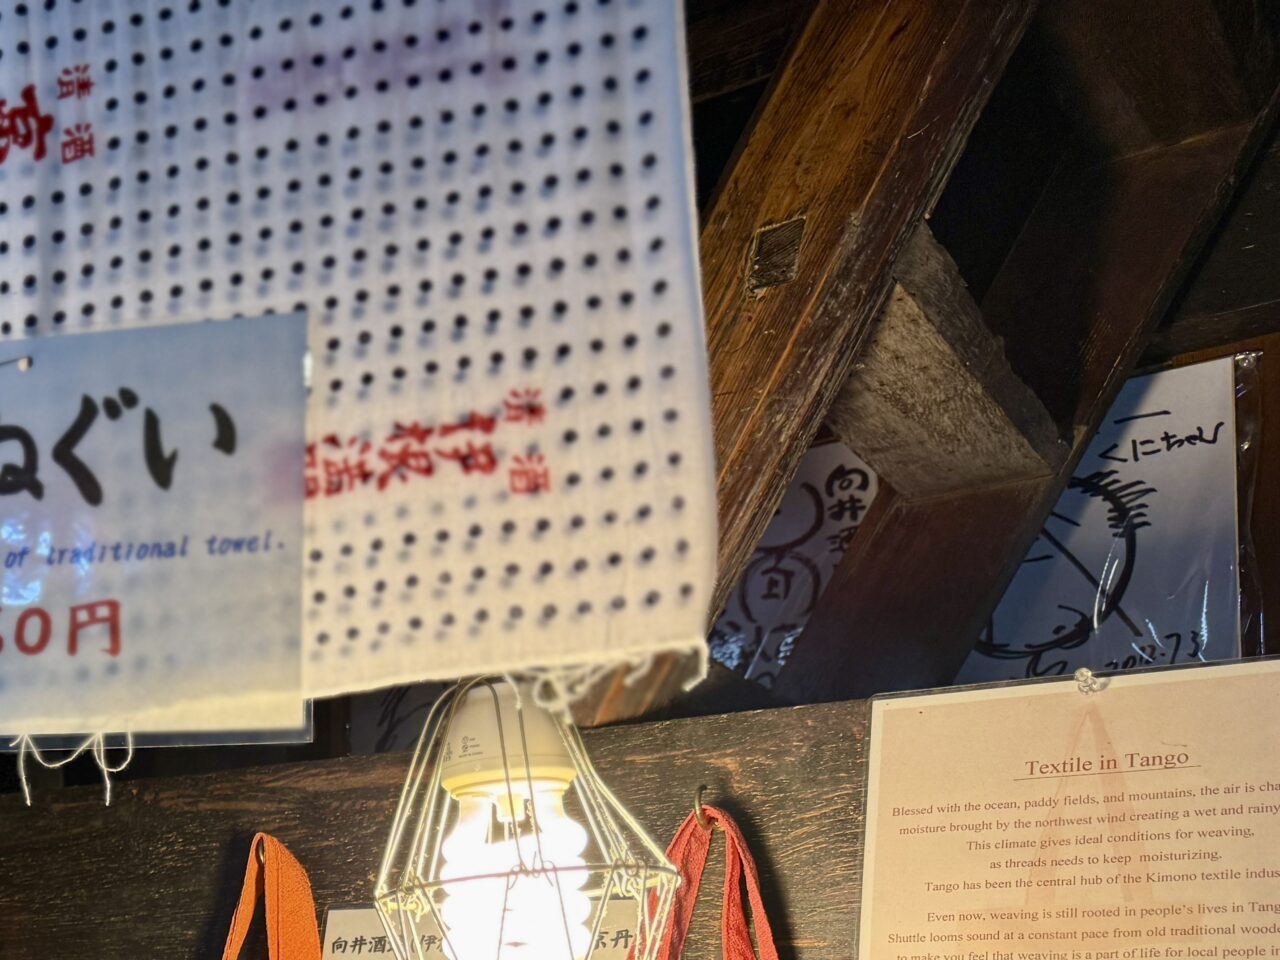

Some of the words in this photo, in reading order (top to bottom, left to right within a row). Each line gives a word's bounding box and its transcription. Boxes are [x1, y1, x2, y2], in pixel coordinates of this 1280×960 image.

[4, 545, 29, 569] of
[46, 535, 188, 568] traditional
[205, 531, 285, 557] towel.
[1025, 756, 1093, 776] Textile
[1099, 754, 1118, 771] in
[1124, 752, 1190, 770] Tango
[892, 804, 933, 817] Blessed
[936, 803, 961, 813] with
[964, 802, 981, 812] the
[1024, 796, 1059, 811] paddy
[1102, 791, 1125, 804] and
[1200, 785, 1220, 796] the
[1223, 783, 1241, 795] air
[1244, 782, 1256, 793] is
[966, 840, 991, 851] This
[994, 839, 1037, 849] climate
[1039, 837, 1071, 850] gives
[1075, 833, 1103, 845] ideal
[1106, 830, 1171, 843] conditions
[1175, 829, 1194, 840] for
[989, 861, 1002, 869] as
[1005, 857, 1047, 869] threads
[1050, 855, 1084, 867] needs
[1087, 856, 1100, 865] to
[1103, 854, 1132, 866] keep
[927, 912, 955, 922] Even
[990, 909, 1039, 922] weaving
[1042, 908, 1052, 919] is
[1055, 907, 1078, 919] still
[1081, 906, 1121, 918] rooted
[1124, 906, 1136, 917] in
[1197, 903, 1228, 914] lives
[1232, 902, 1244, 913] in
